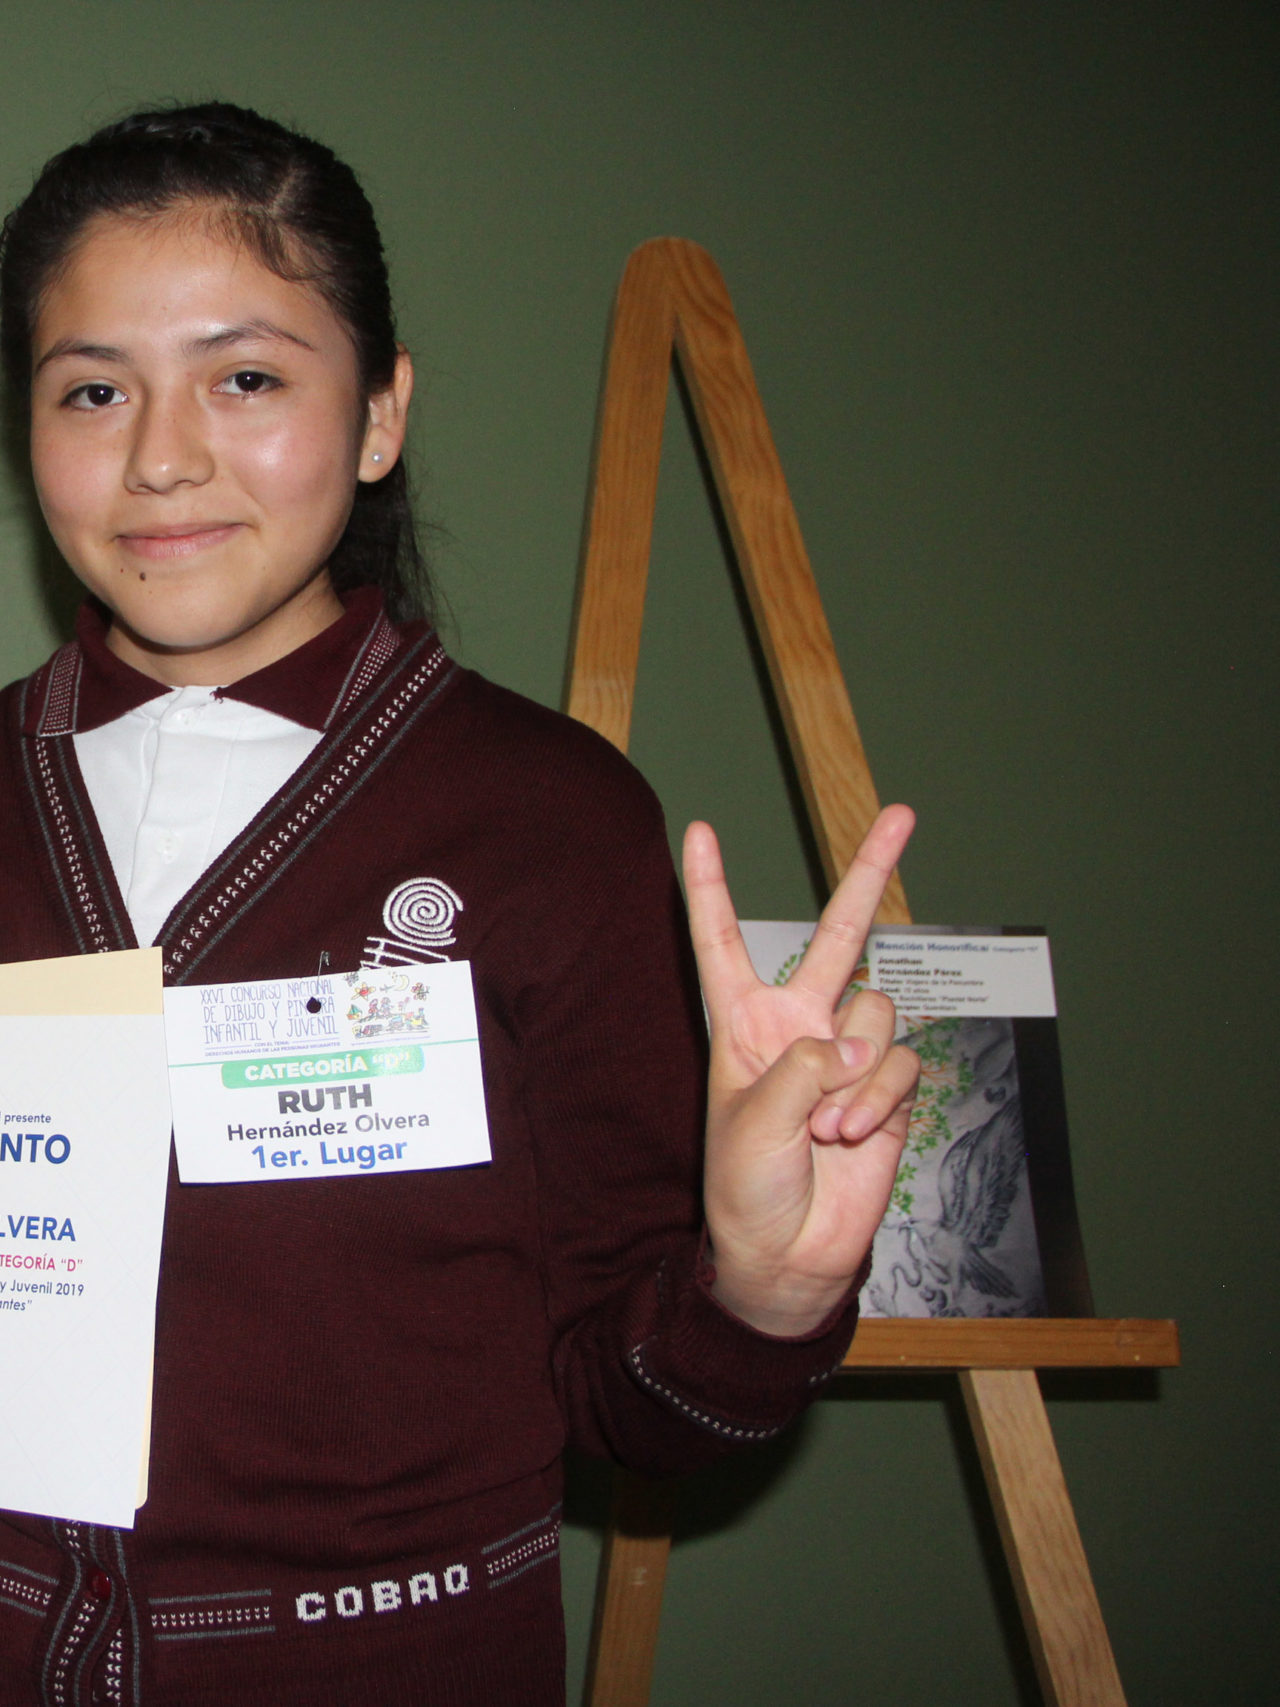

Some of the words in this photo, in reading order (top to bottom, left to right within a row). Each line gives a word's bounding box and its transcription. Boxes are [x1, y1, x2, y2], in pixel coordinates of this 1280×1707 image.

[875, 941, 924, 951] Mención
[878, 957, 923, 965] Jonathan
[878, 968, 931, 976] Hernández
[200, 988, 224, 1004] XXVI
[230, 984, 281, 1002] CONCURSO
[287, 979, 334, 997] NACIONAL
[203, 1006, 216, 1023] DE
[225, 1002, 265, 1021] DIBUJO
[272, 1001, 280, 1018] Y
[204, 1022, 261, 1044] INFANTIL
[269, 1020, 277, 1038] Y
[287, 1015, 339, 1038] JUVENIL
[244, 1054, 368, 1081] CATEGORÍA
[278, 1083, 373, 1114] RUTH
[4, 1113, 51, 1125] presente
[227, 1118, 348, 1141] Hernández
[355, 1112, 430, 1132] Olvera
[251, 1145, 308, 1168] 1er.
[320, 1141, 408, 1170] Lugar
[0, 1281, 7, 1293] y
[10, 1279, 52, 1295] Juvenil
[56, 1282, 85, 1297] 2019
[296, 1563, 470, 1622] COBAQ
